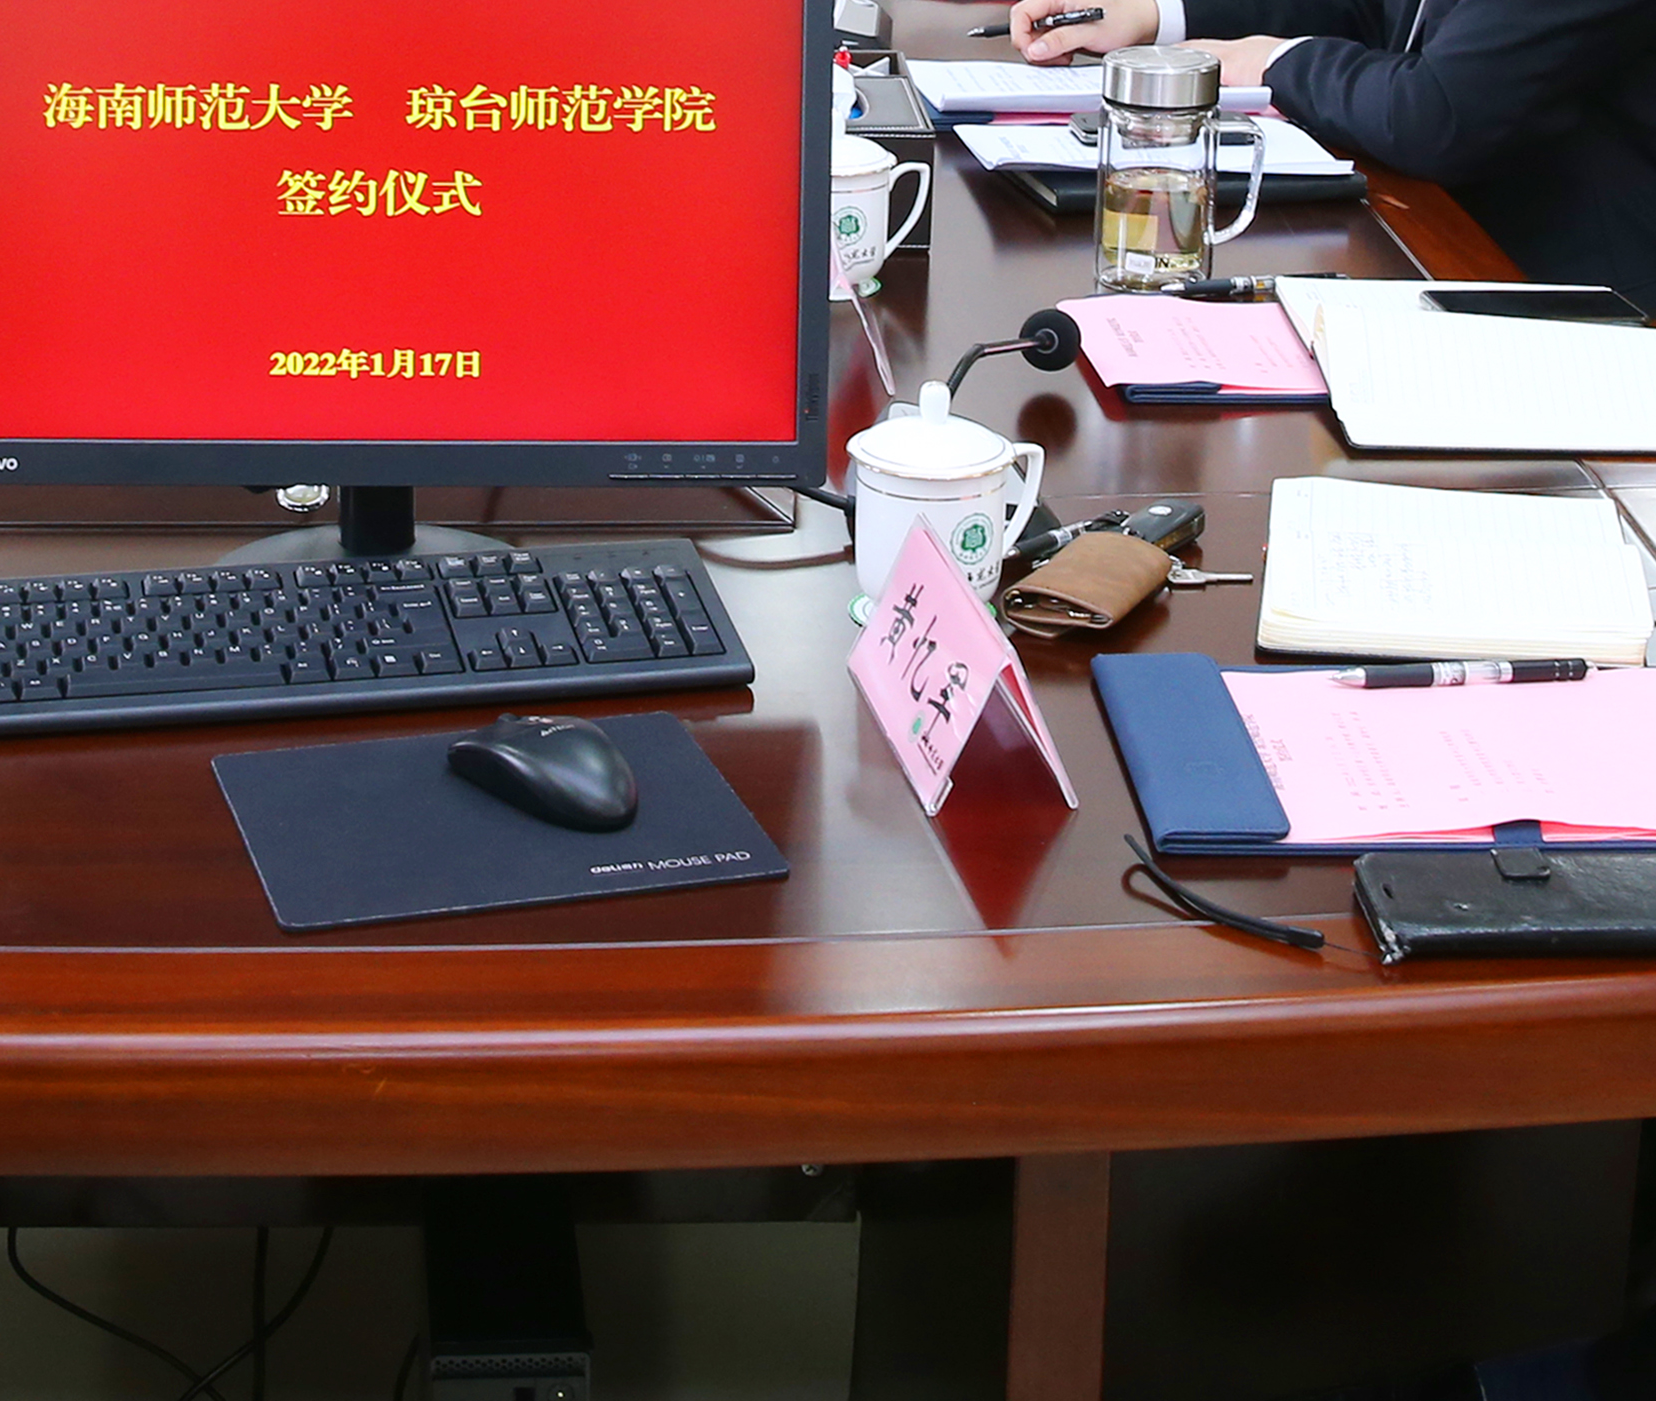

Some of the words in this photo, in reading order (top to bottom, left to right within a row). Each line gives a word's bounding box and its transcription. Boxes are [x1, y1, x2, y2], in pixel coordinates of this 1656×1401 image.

[42, 82, 354, 130] 海南师范大学
[405, 84, 717, 133] 琼台师范学院
[275, 170, 483, 217] 签约仪式
[269, 348, 482, 380] 2022年1月17日
[647, 854, 712, 871] MOUSE
[714, 851, 751, 863] PAD
